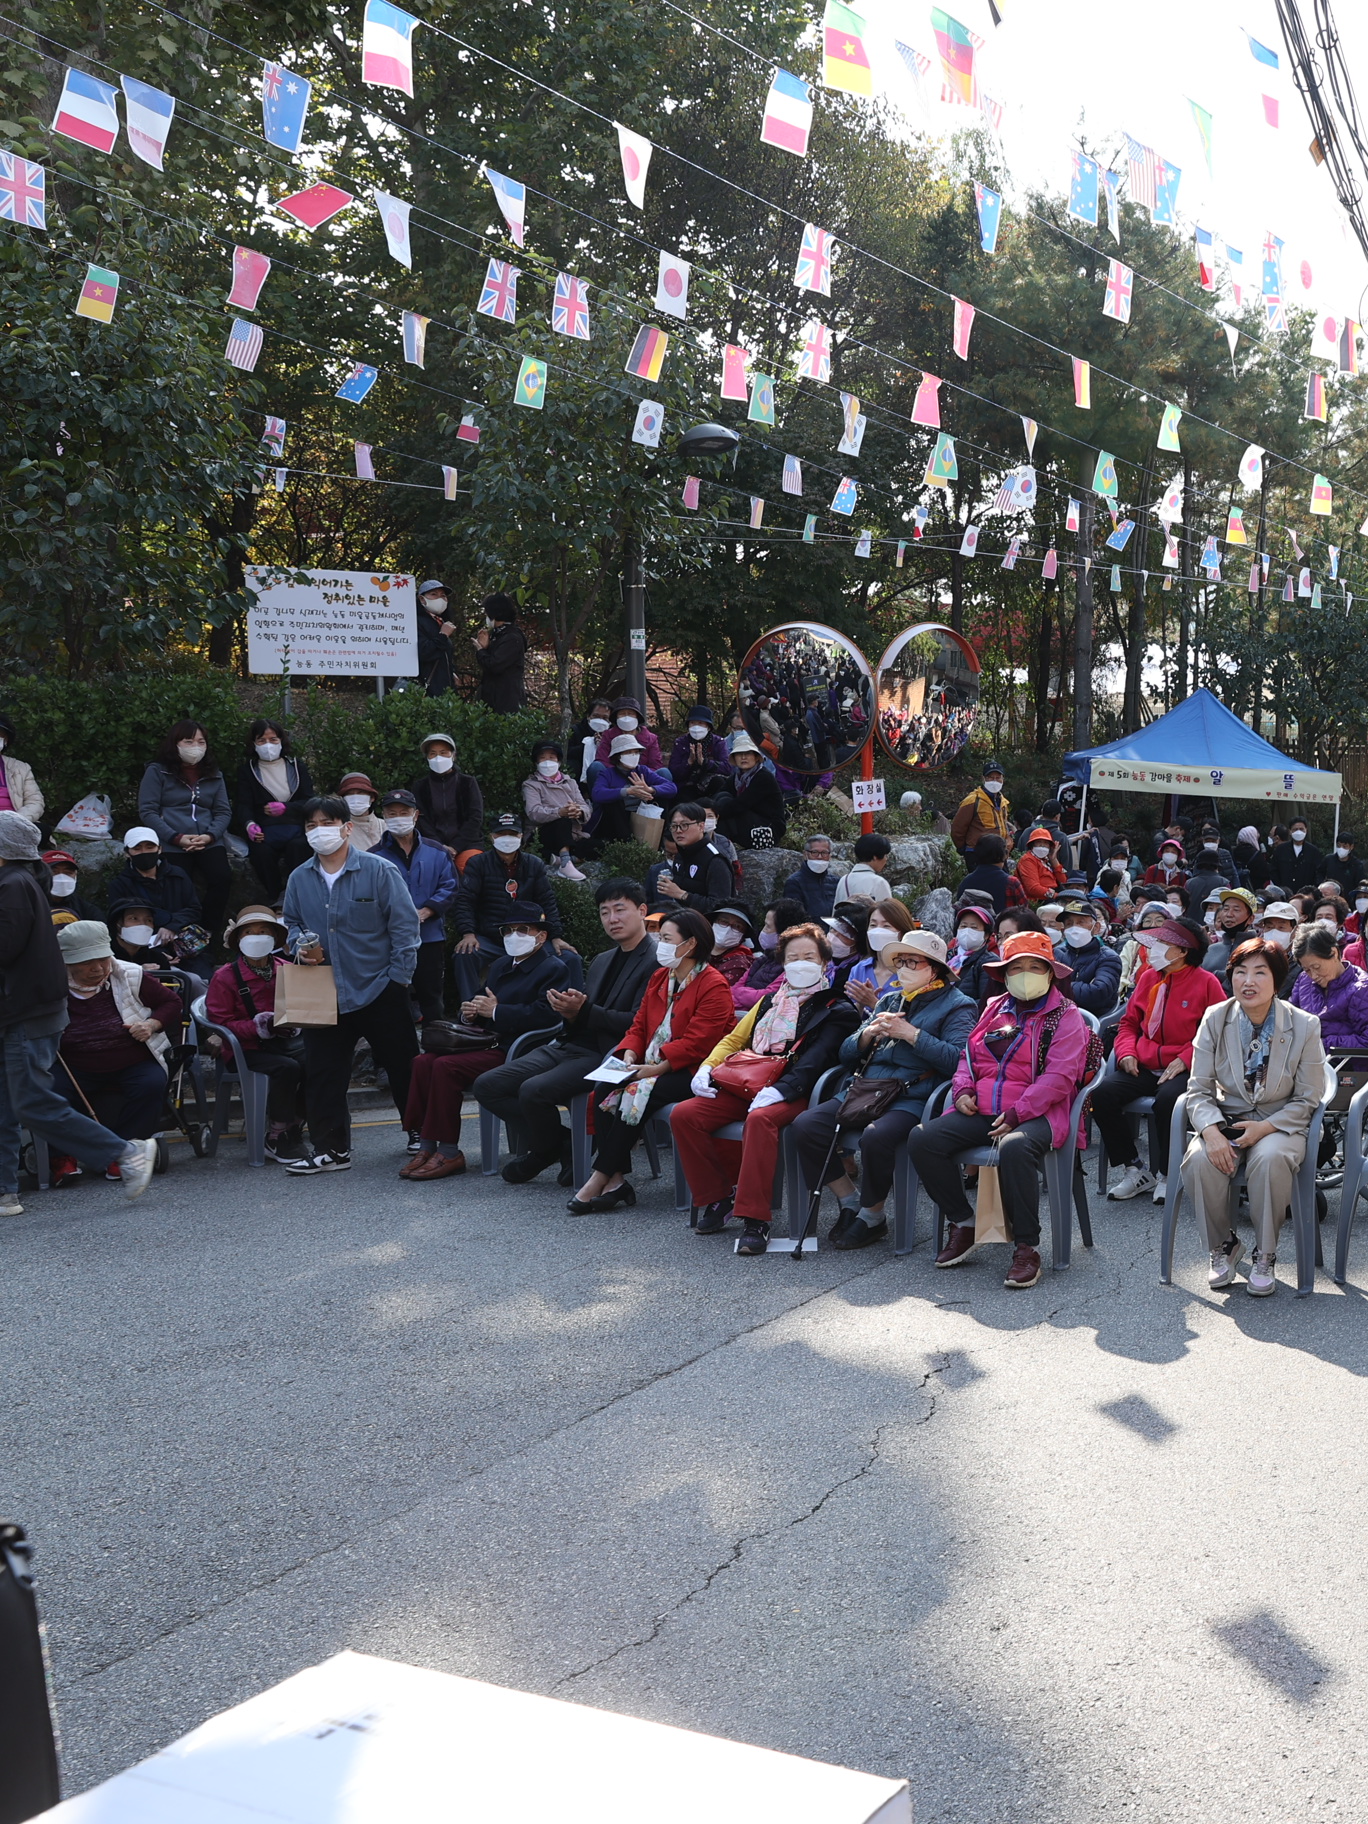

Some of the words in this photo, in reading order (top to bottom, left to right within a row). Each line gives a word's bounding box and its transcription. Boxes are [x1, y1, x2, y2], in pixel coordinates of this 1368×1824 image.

[310, 577, 354, 591] 익어가는
[322, 592, 366, 606] 정취있는
[296, 659, 313, 669] 능동
[319, 660, 377, 669] 주민자치위원회
[1117, 770, 1129, 779] 5회
[1131, 771, 1146, 782] 능동
[1175, 773, 1191, 784] 축제
[1210, 770, 1224, 786] 알
[1283, 774, 1294, 790] 뜰
[855, 782, 882, 795] 화장실
